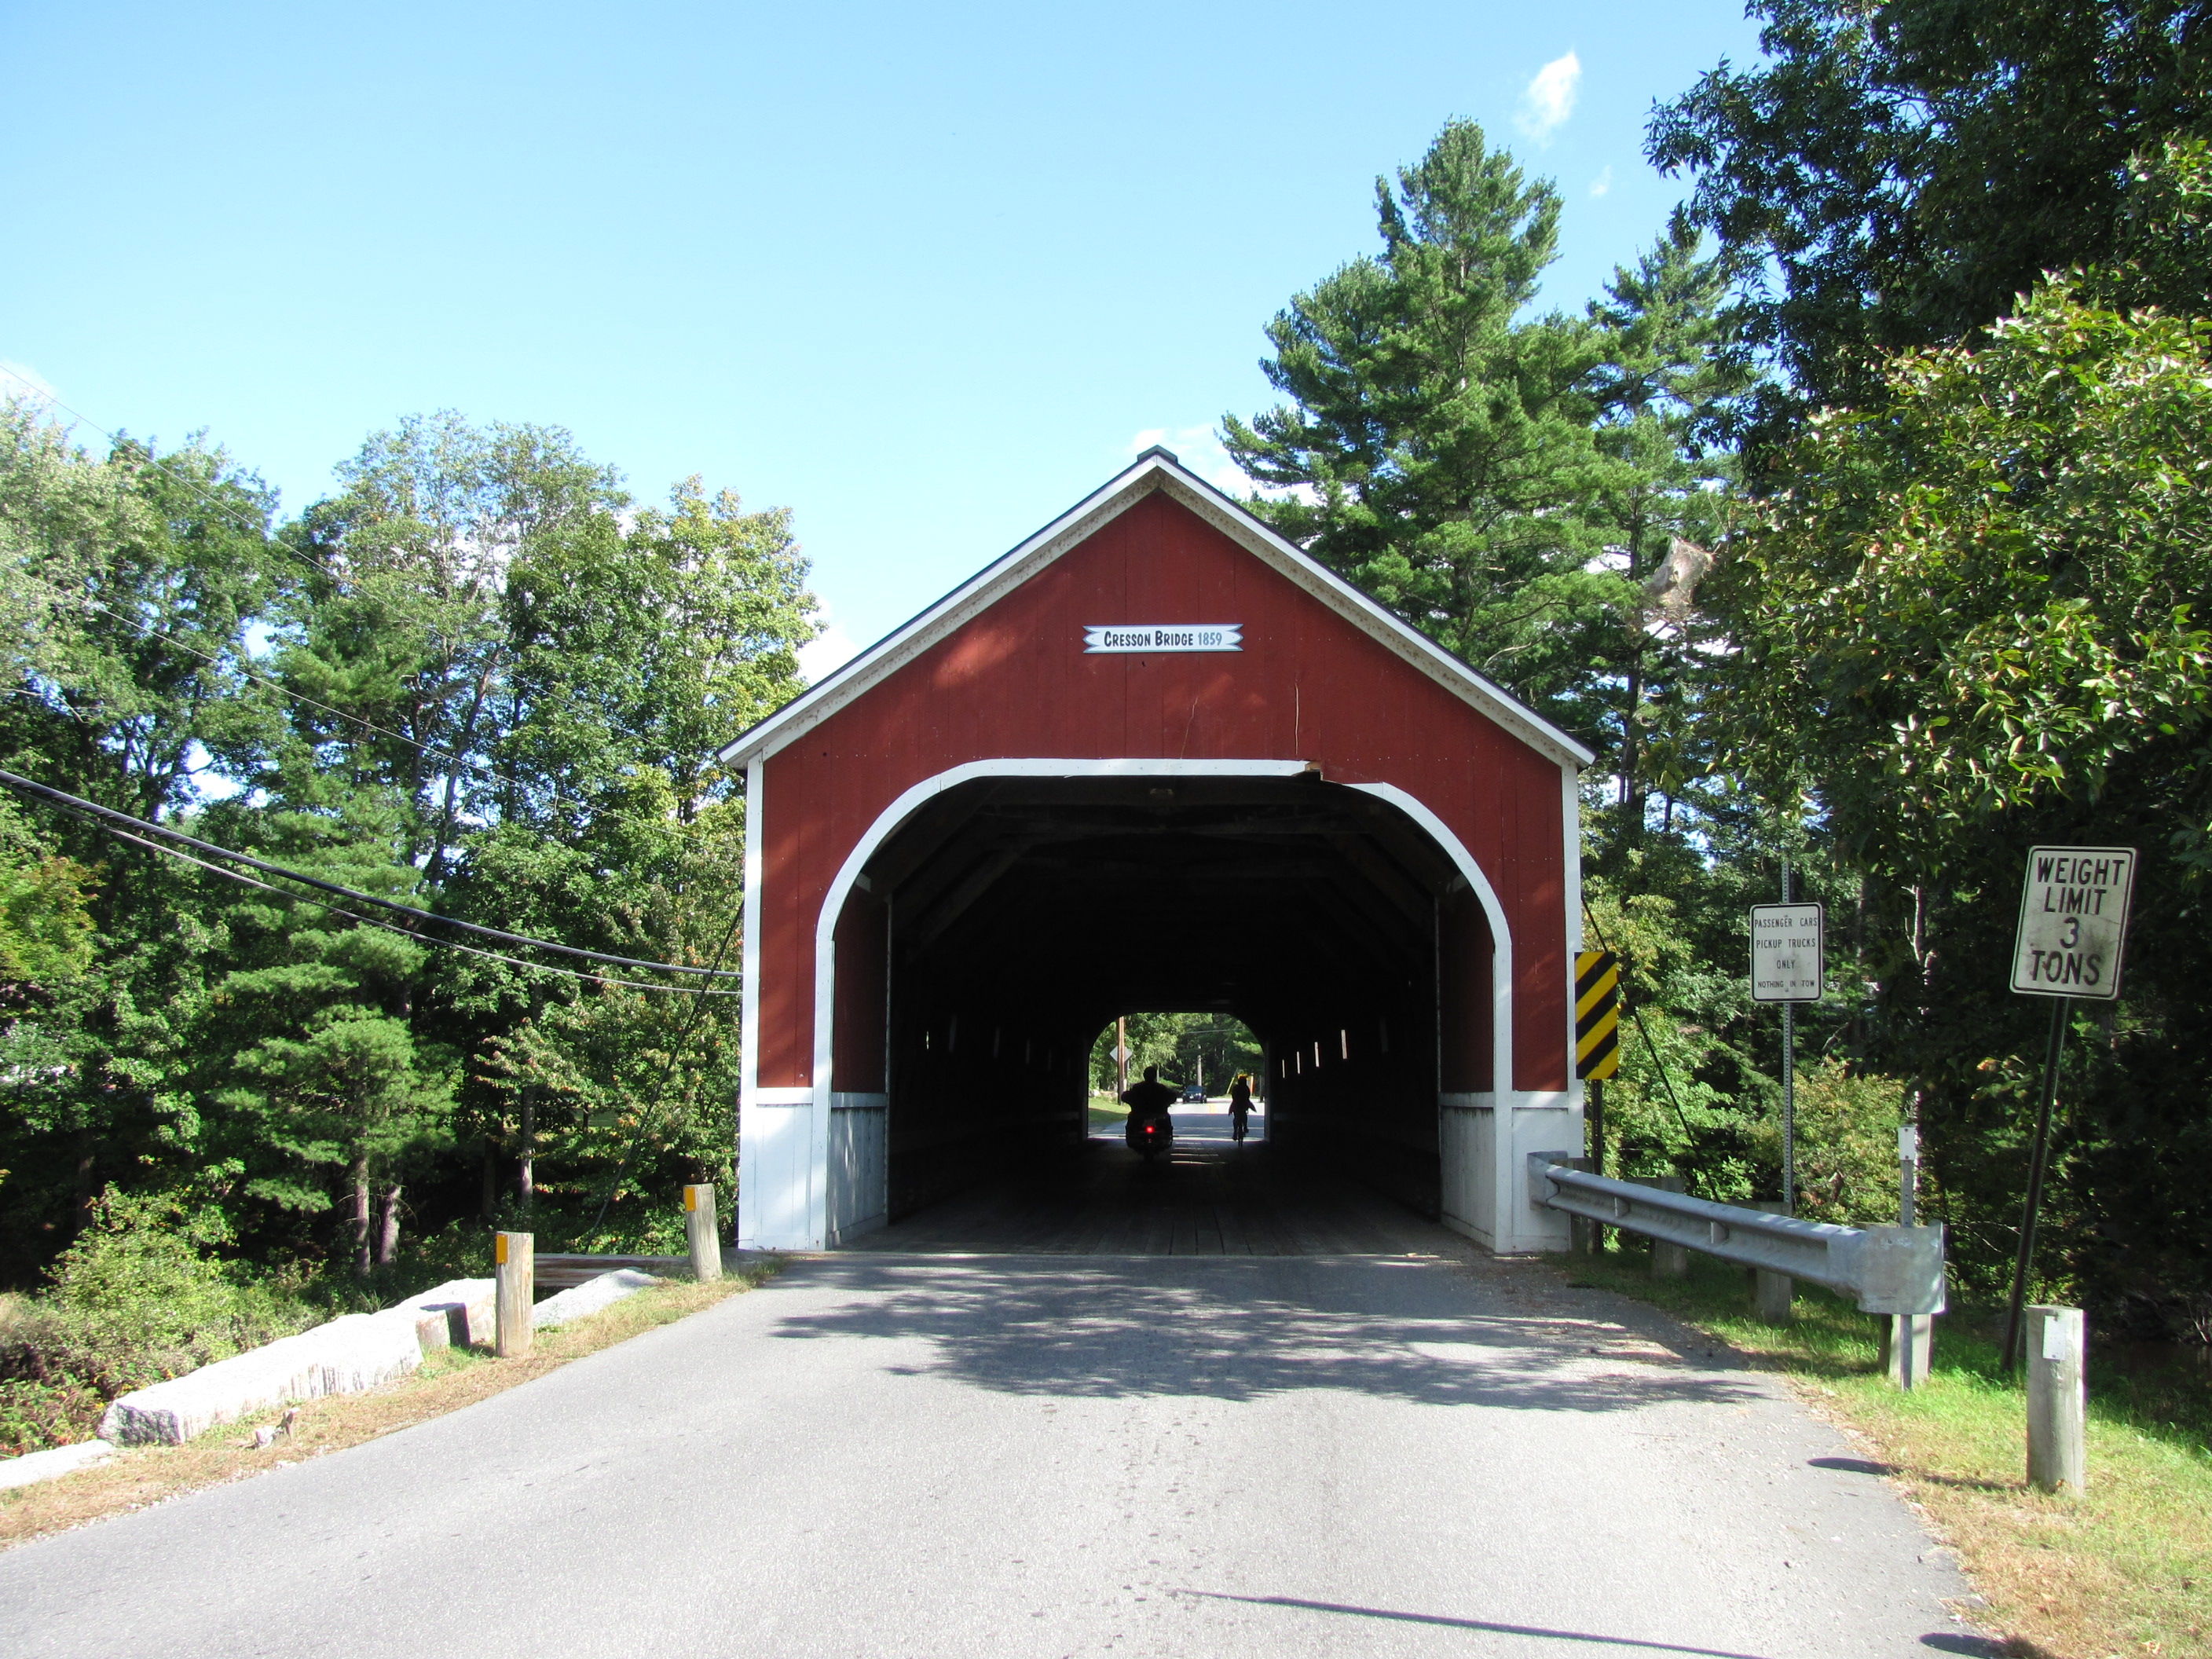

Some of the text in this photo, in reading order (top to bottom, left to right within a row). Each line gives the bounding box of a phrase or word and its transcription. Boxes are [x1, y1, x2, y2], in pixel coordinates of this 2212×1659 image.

[1104, 630, 1222, 647] CRESSON BRIDGE 1859
[2038, 857, 2125, 885] WEIGHT
[2044, 886, 2107, 915] LIMIT
[1754, 917, 1818, 928] PASSENGER CARS
[2060, 917, 2080, 949] 3
[1756, 938, 1816, 949] PICKUP TRUCKS
[1776, 959, 1796, 969] ONLY
[2031, 950, 2102, 986] TONS
